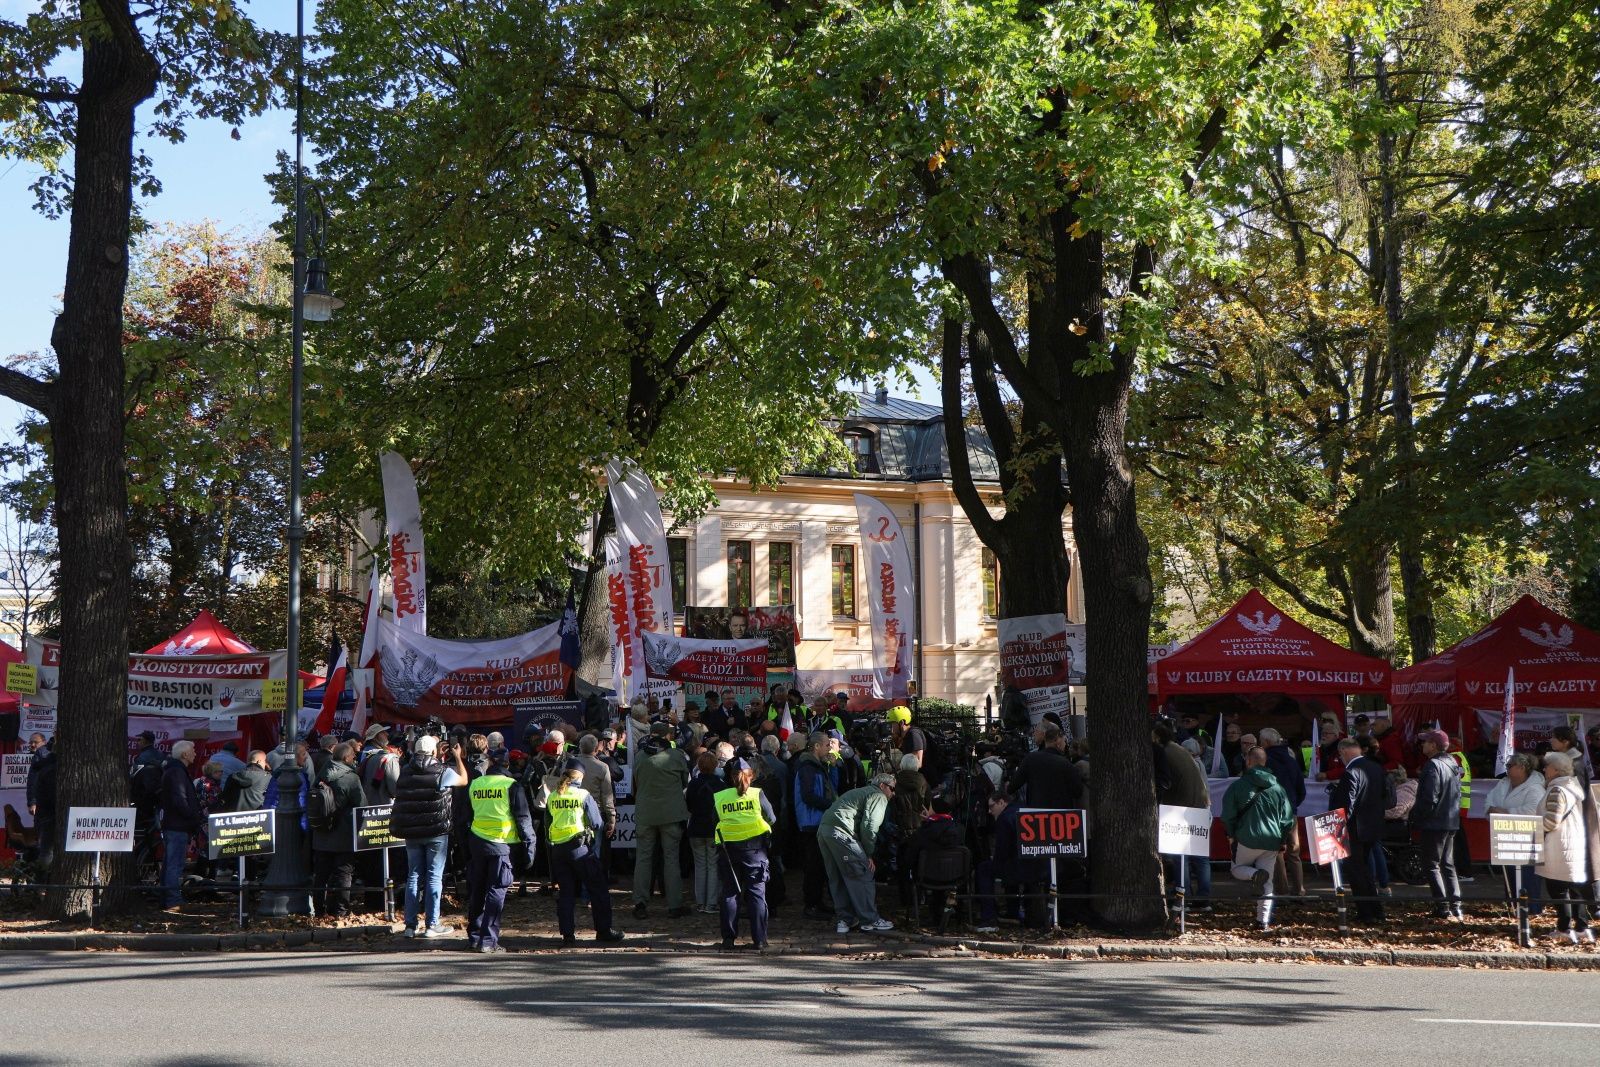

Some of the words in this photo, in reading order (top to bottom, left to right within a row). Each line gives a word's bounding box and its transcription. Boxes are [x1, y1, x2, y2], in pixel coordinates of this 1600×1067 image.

[1017, 632, 1042, 641] KLUB
[712, 646, 737, 654] KLUB
[1029, 640, 1067, 652] POLSKIEJ
[1232, 642, 1301, 650] PIOTRKÓW
[486, 656, 521, 670] KLUB
[682, 654, 720, 663] GAZETY
[723, 655, 766, 664] POLSKIEJ
[132, 658, 264, 675] KONSTYTUCYJNY
[441, 671, 495, 682] GAZETY
[501, 662, 563, 680] POLSKIEJ
[702, 663, 732, 675] ŁÓDŹ
[736, 667, 744, 675] II
[1014, 664, 1053, 678] ŁÓDZKI
[1185, 671, 1232, 683] KLUBY
[1236, 670, 1292, 682] GAZETY
[1297, 671, 1364, 685] POLSKIEJ
[128, 681, 149, 692] TNI
[151, 681, 213, 695] BASTION
[440, 679, 564, 696] KIELCE-CENTRUM
[1485, 683, 1534, 694] KLBY
[1538, 680, 1596, 692] GAZETY
[129, 694, 213, 710] ORZĄDNOŚCI
[453, 698, 507, 707] PRZEMYSŁAWA
[473, 789, 502, 799] POLICJA
[552, 799, 579, 809] POLICJA
[722, 801, 754, 814] POLICJA
[76, 817, 99, 828] WOLNI
[101, 818, 128, 828] POLACY
[1020, 812, 1080, 841] STOP
[72, 829, 130, 841] #BĄDŹMYRAZEM
[1021, 844, 1057, 856] bezprawiu
[1058, 842, 1082, 854] Tuska!
